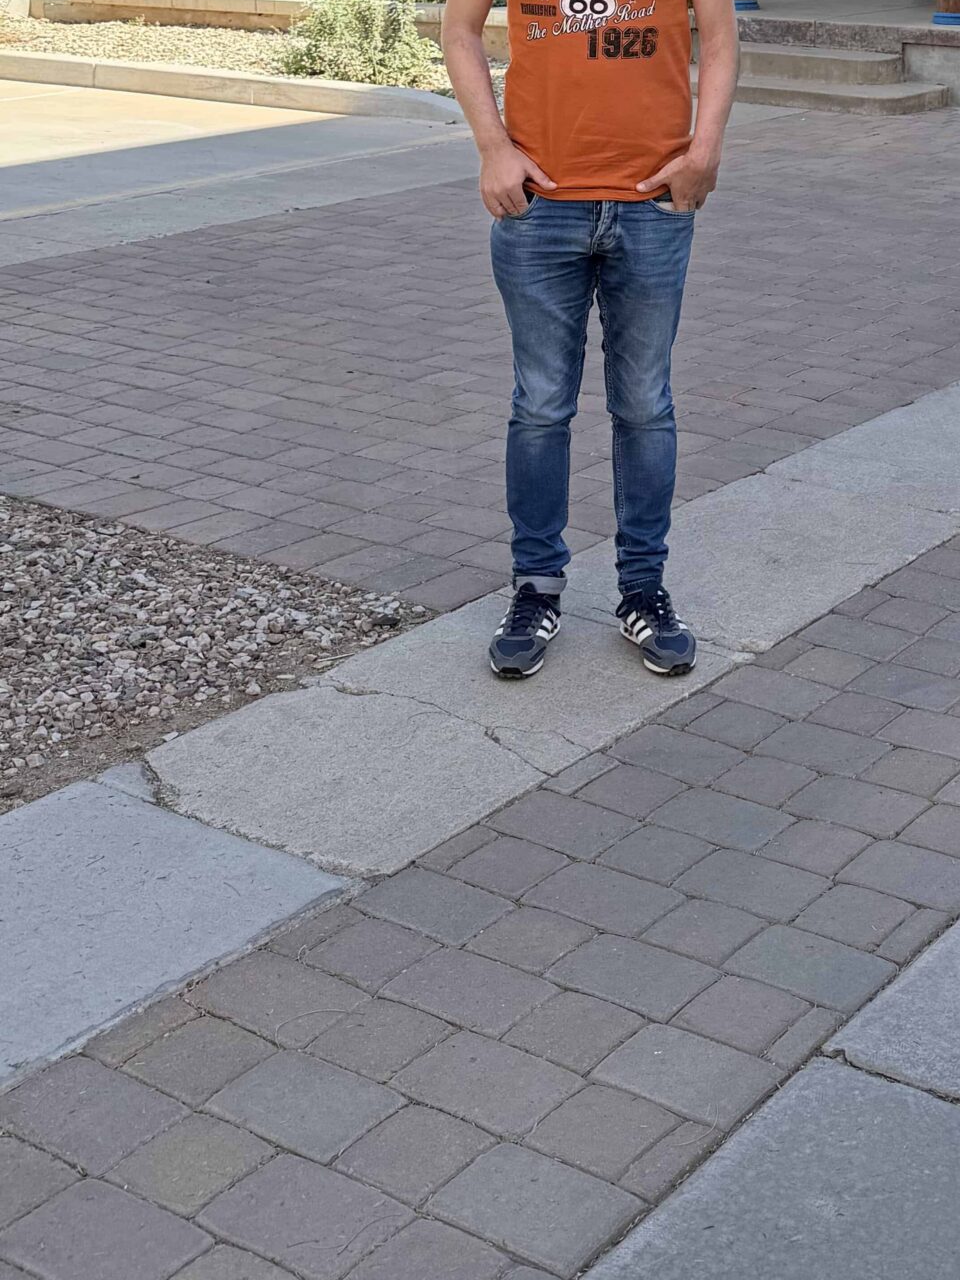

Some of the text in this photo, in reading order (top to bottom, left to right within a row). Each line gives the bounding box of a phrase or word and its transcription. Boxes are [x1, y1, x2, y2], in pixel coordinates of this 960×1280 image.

[526, 0, 656, 41] The Mother Road
[587, 26, 659, 59] 1926
